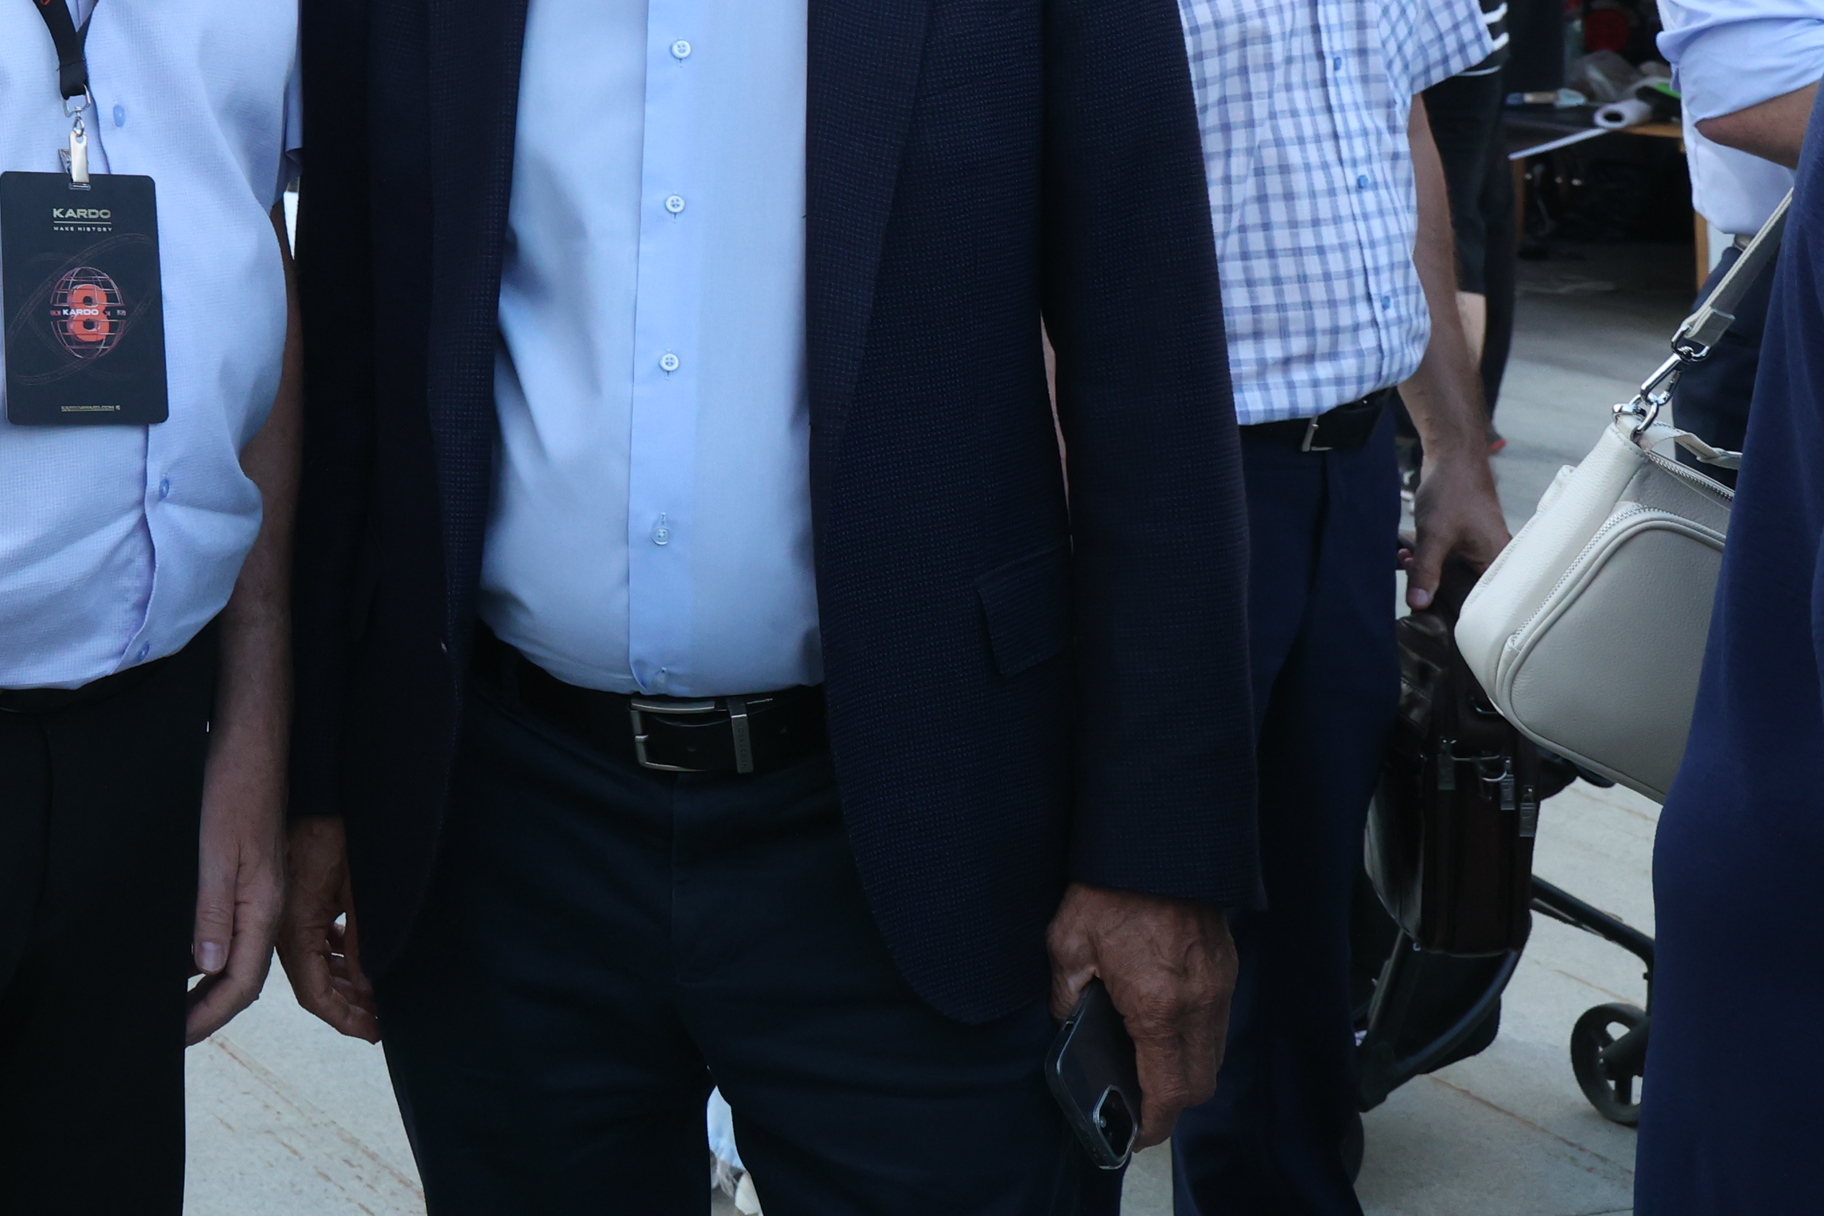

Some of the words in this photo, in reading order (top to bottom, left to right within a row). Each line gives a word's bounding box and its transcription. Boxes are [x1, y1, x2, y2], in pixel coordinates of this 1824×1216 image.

[52, 207, 112, 219] KARDO
[62, 308, 100, 316] KARDO
[67, 284, 110, 342] 8
